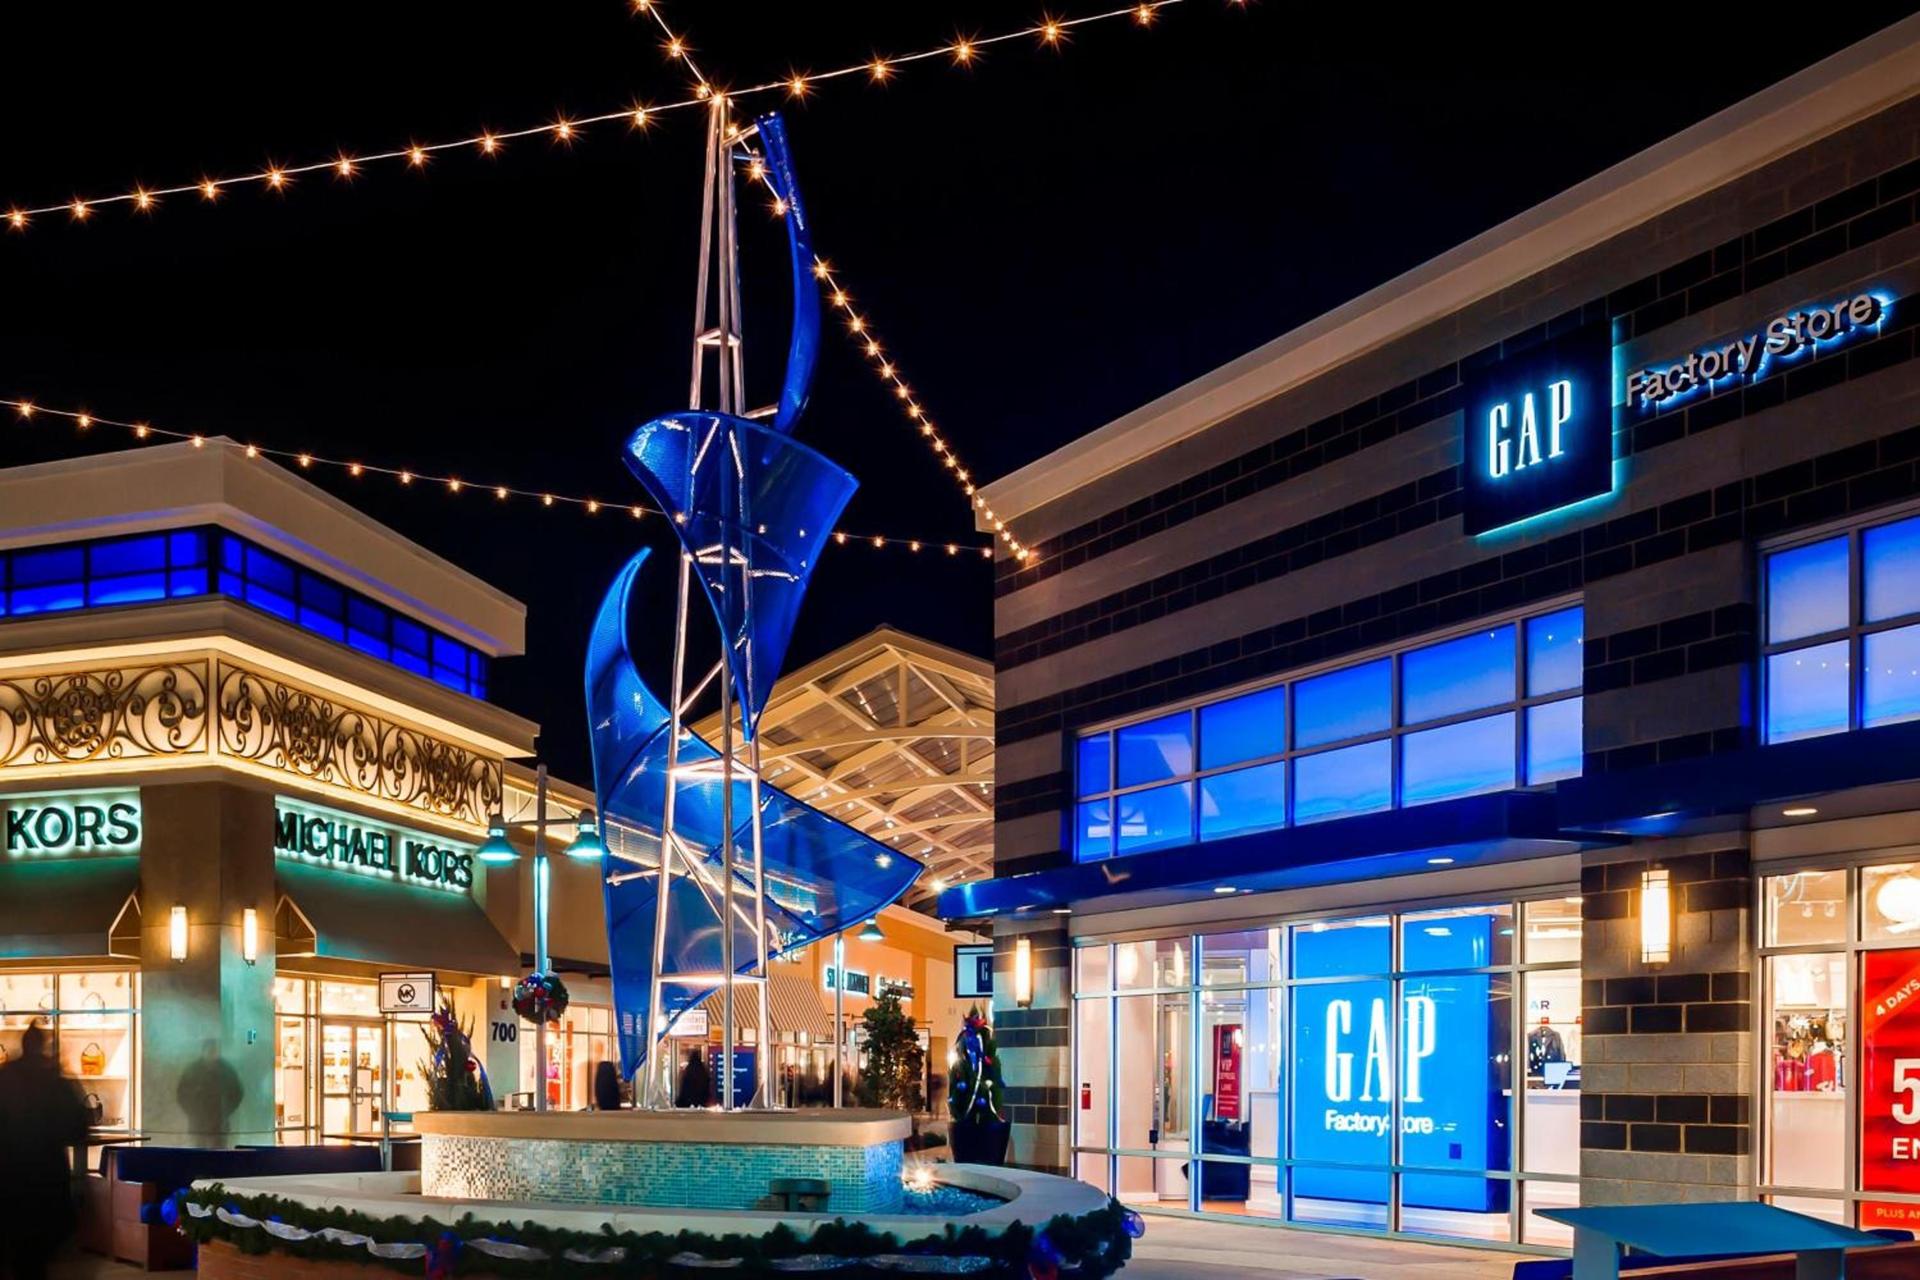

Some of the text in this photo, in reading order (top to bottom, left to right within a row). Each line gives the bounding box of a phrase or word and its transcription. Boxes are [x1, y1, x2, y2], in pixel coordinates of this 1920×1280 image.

[1626, 294, 1874, 407] Factory Store
[1488, 379, 1572, 478] GAP
[7, 803, 139, 850] KORS
[274, 808, 473, 888] MICHAEL KORS
[1876, 979, 1920, 1016] 4 DAYS
[492, 1022, 517, 1042] 700
[1325, 997, 1436, 1102] GAP
[1325, 1109, 1387, 1137] Factory
[1876, 1207, 1905, 1219] PLUS
